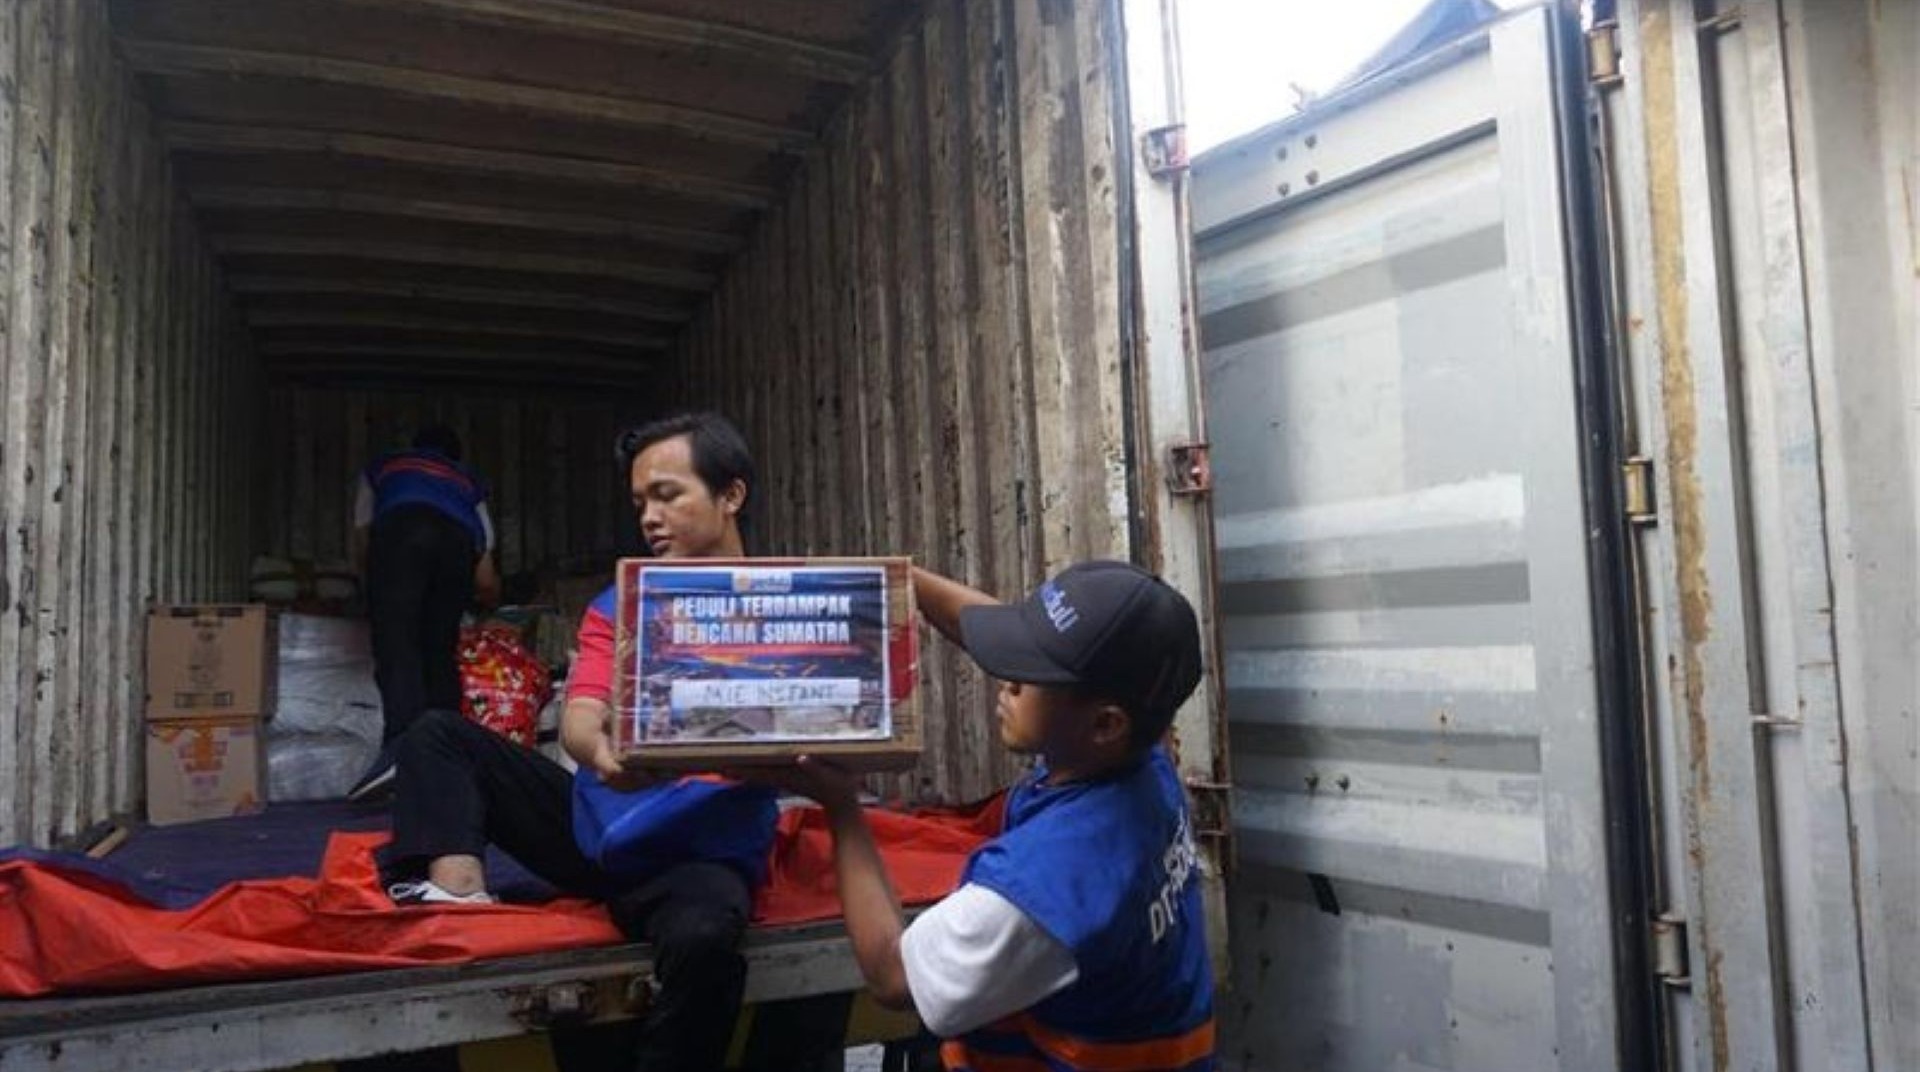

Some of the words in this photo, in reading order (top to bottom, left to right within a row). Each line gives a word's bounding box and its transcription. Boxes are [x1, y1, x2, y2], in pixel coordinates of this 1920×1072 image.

[673, 595, 735, 618] PEDULI
[742, 595, 851, 617] TERDAMPAK
[673, 621, 757, 645] BENCANA
[762, 621, 851, 645] SUMATRA
[757, 683, 839, 704] INSTANT
